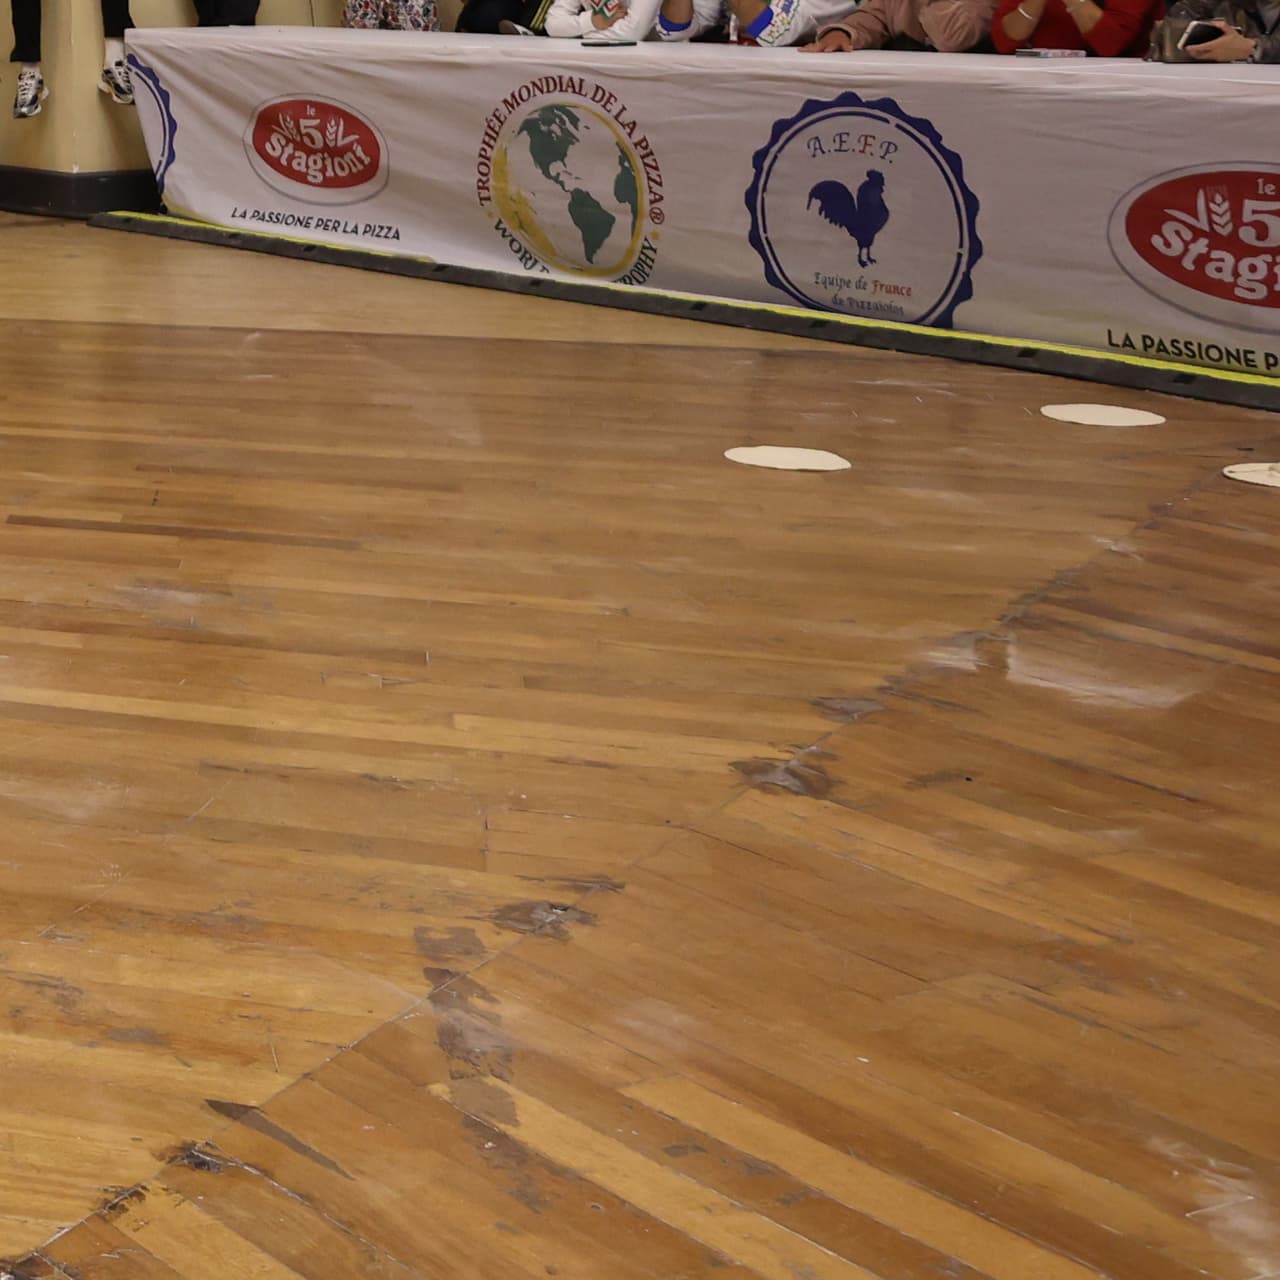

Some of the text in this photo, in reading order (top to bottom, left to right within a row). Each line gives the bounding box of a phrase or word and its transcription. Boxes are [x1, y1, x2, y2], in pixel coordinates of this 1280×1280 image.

[307, 104, 316, 116] le
[299, 118, 324, 149] 5
[476, 107, 507, 207] TROPHÉE
[503, 74, 588, 116] MONDIAL
[590, 83, 618, 113] DE
[613, 104, 639, 139] LA
[264, 132, 371, 184] Stagioni
[1256, 178, 1276, 196] le
[231, 207, 401, 241] LA PASSIONE PER LA PIZZA
[1238, 199, 1280, 248] 5
[814, 271, 913, 297] Equipe de France
[1107, 329, 1136, 350] LA
[1141, 334, 1257, 368] PASSIONE
